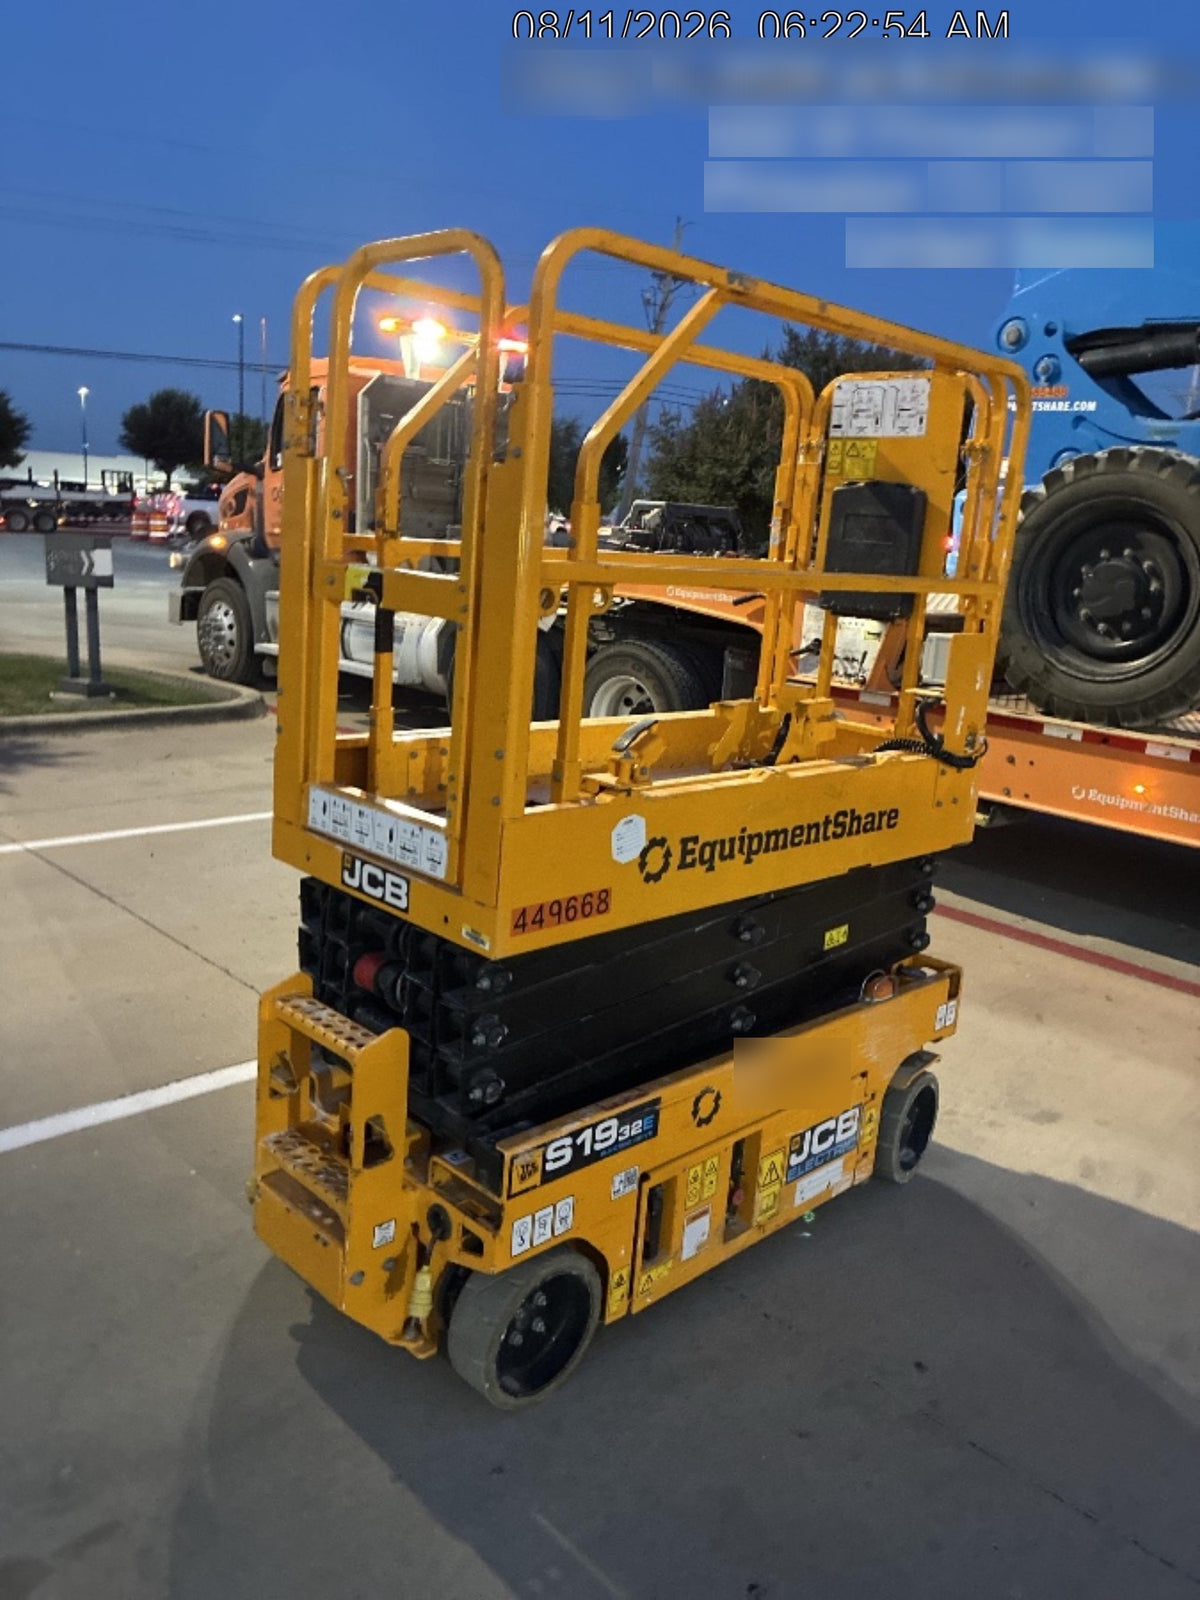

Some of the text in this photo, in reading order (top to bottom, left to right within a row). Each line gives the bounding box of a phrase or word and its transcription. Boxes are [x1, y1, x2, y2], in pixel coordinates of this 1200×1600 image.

[676, 808, 899, 873] EquipmentShare
[342, 858, 409, 911] JCB
[513, 888, 610, 933] 449668
[789, 1107, 860, 1167] JCB
